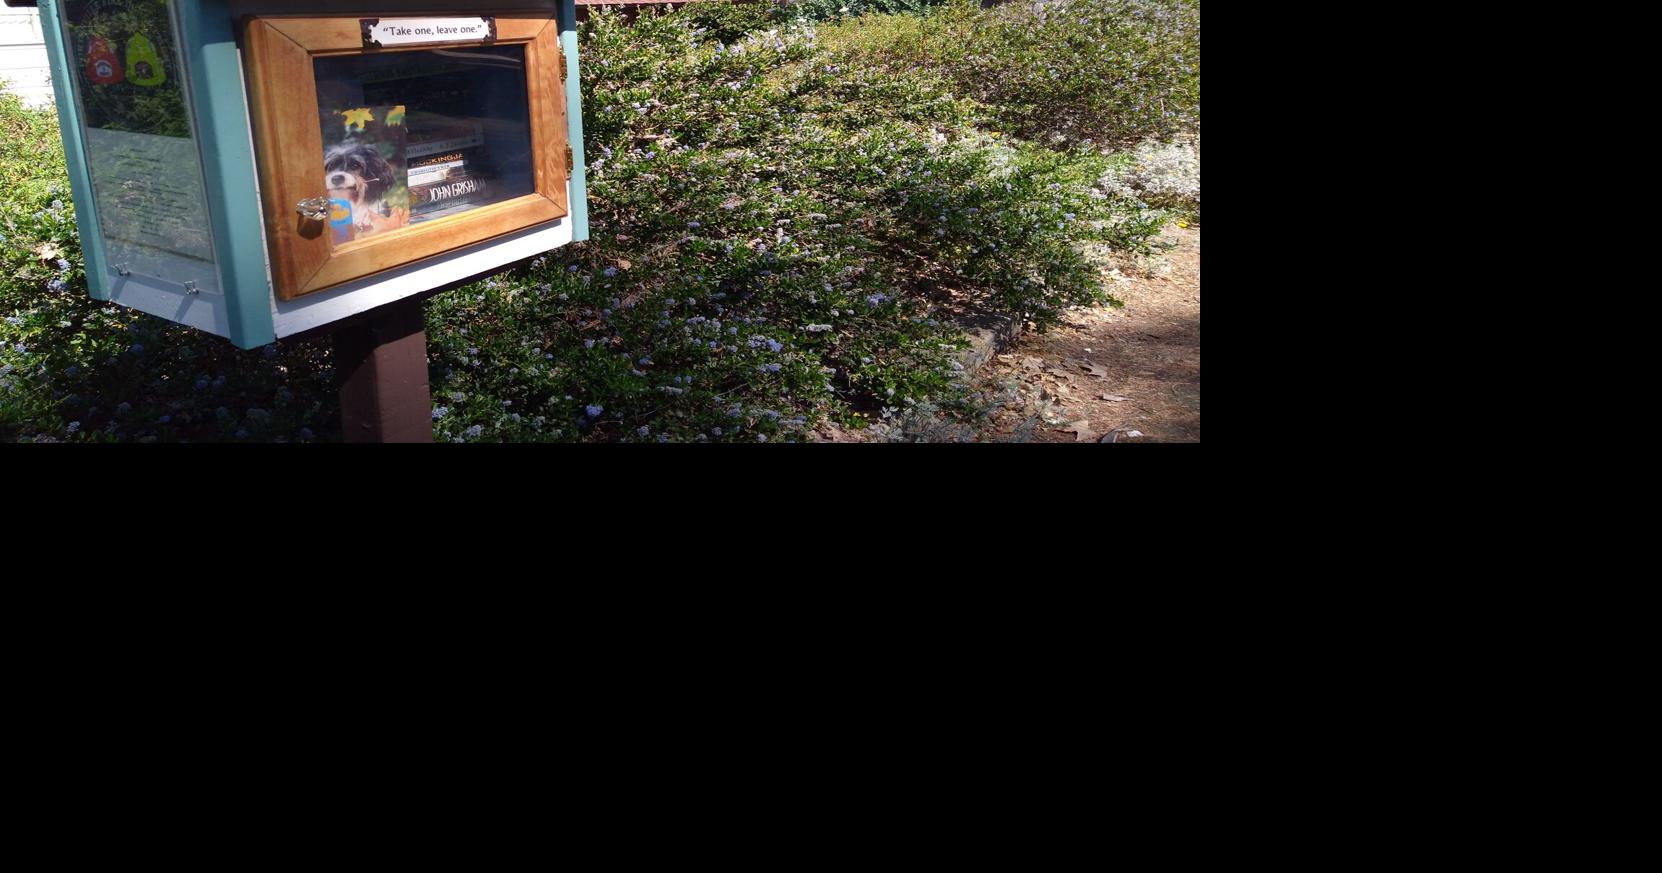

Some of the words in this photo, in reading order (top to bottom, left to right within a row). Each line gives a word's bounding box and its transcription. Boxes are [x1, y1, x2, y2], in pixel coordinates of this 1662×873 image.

[383, 26, 412, 36] “Take
[414, 28, 435, 36] one,
[436, 25, 458, 34] leave
[460, 24, 482, 34] one.”
[429, 184, 451, 202] JOHN
